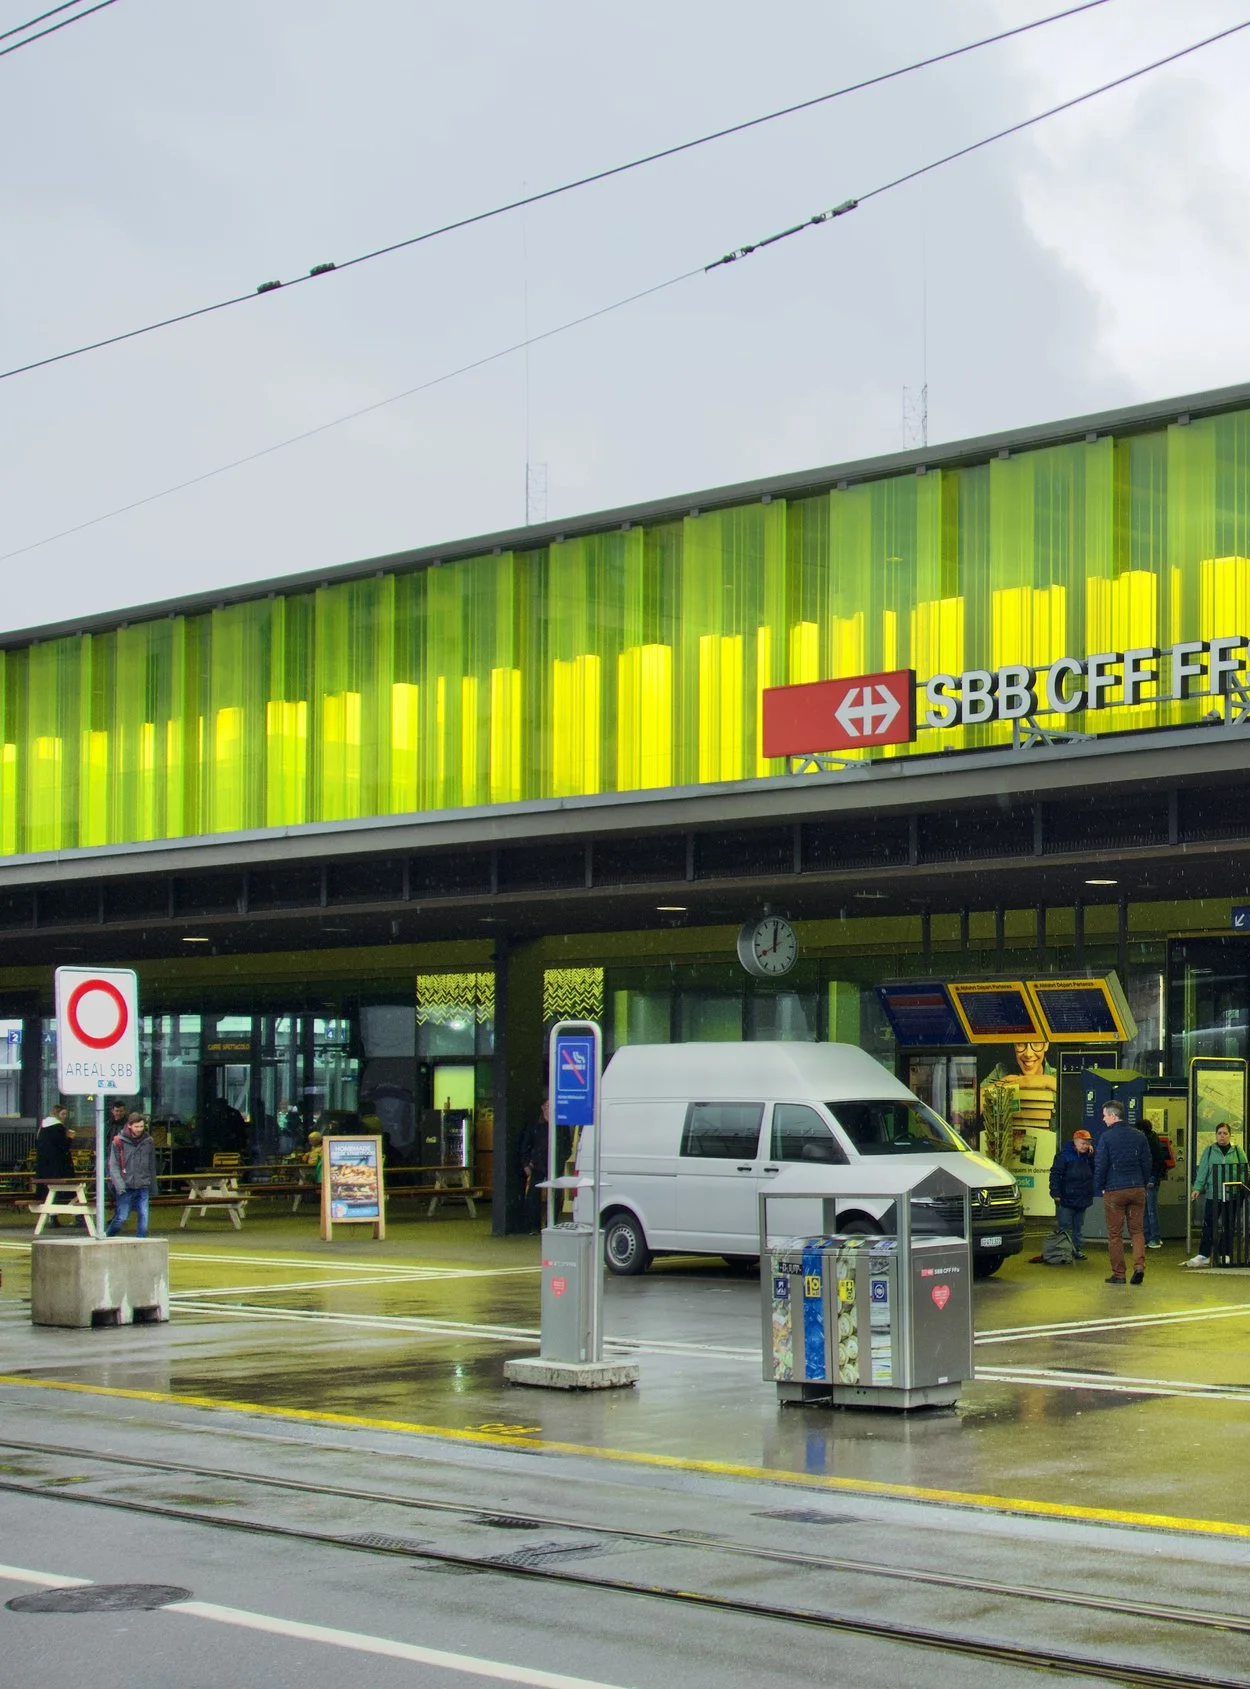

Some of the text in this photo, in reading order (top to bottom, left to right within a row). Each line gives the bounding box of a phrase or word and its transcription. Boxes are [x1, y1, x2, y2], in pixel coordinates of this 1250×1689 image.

[925, 664, 1037, 728] SBB
[1046, 646, 1160, 714] CFF
[11, 1033, 18, 1042] 2
[65, 1063, 133, 1077] AREAL SBB
